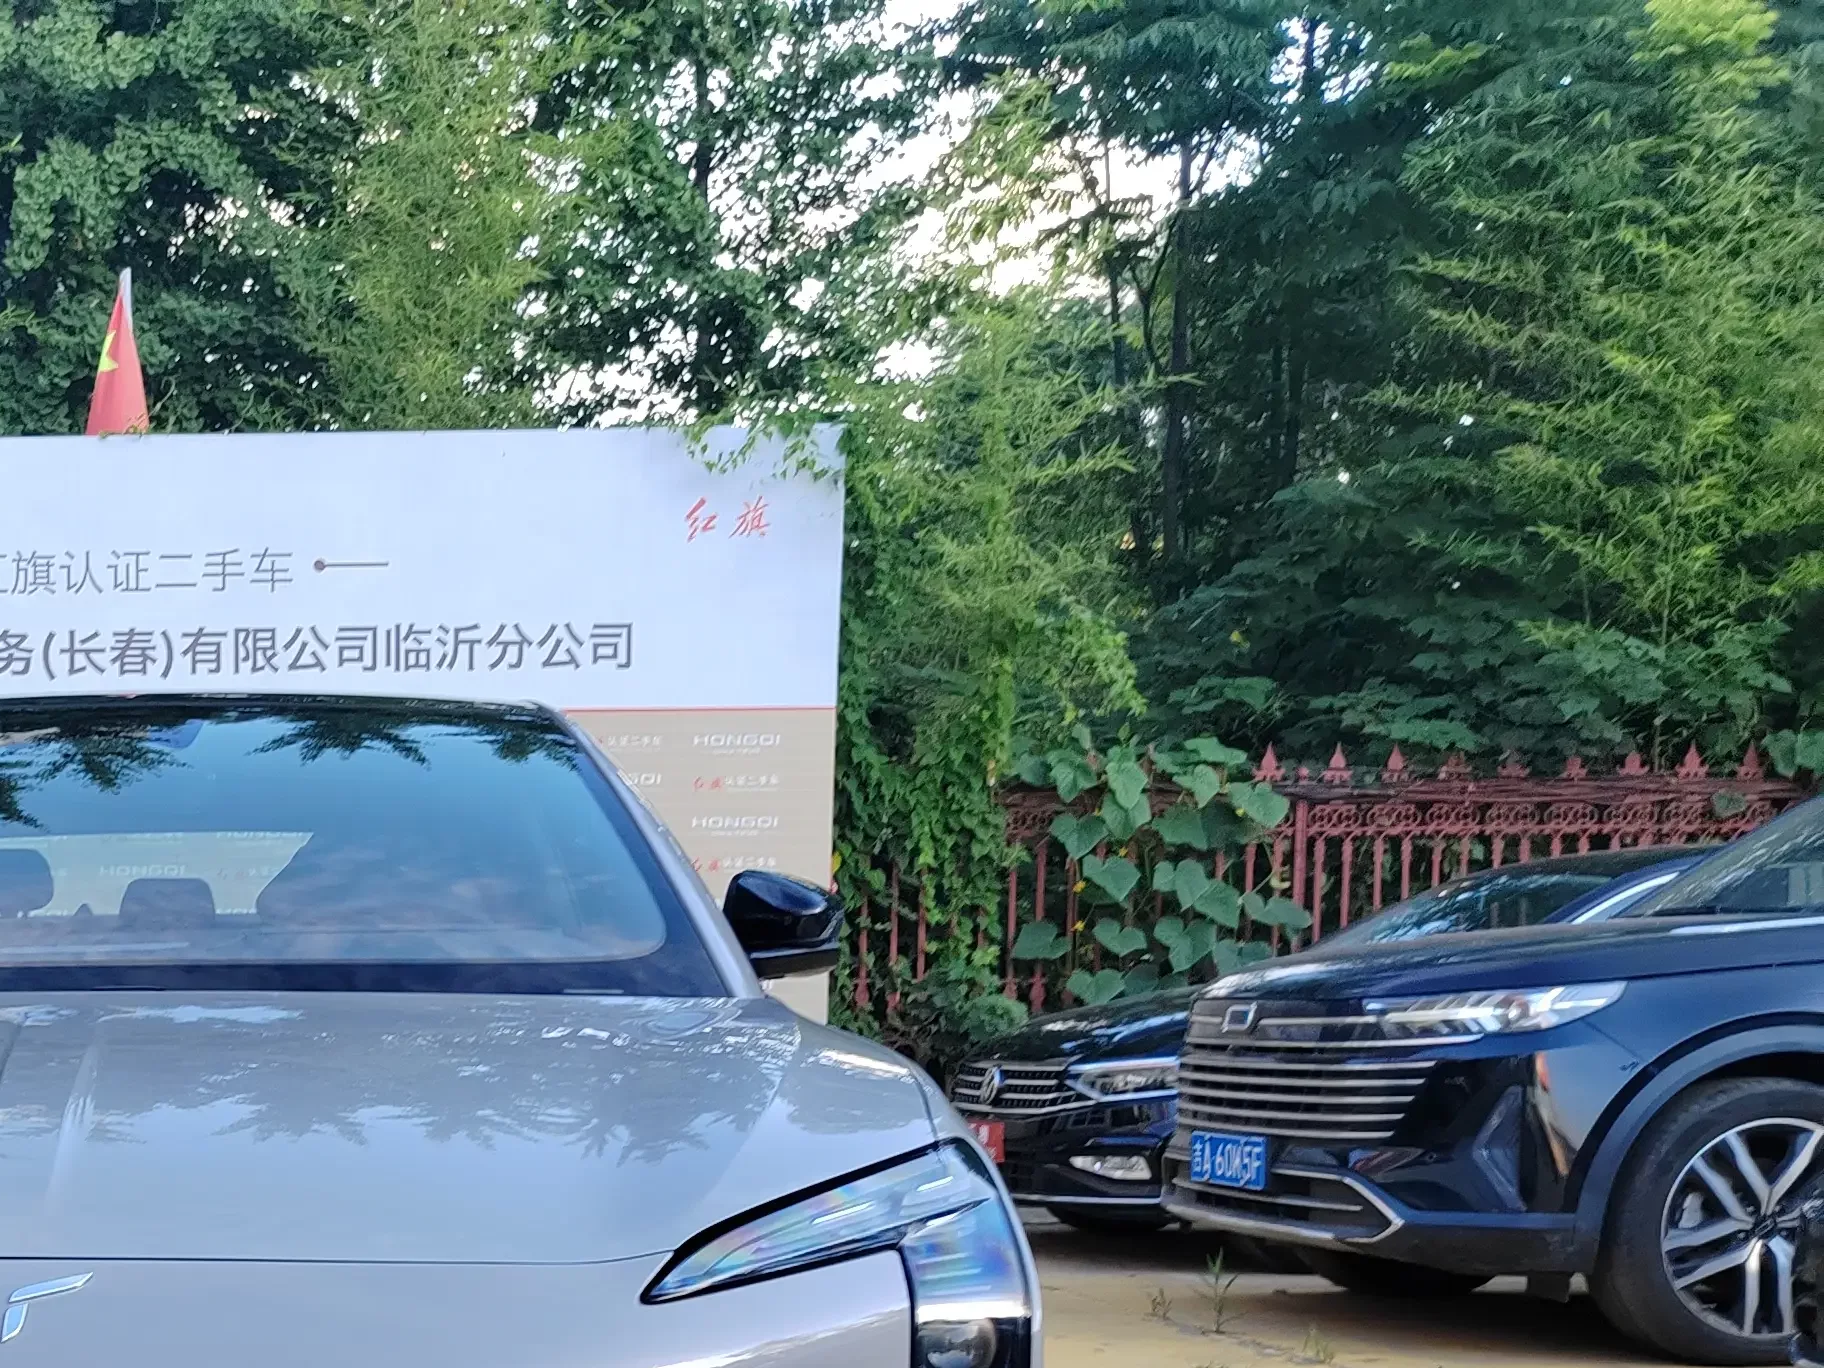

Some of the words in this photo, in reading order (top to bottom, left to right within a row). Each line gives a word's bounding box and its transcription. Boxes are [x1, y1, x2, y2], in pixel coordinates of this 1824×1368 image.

[684, 495, 771, 542] 红旗
[692, 733, 782, 747] HONGQI
[691, 815, 779, 829] HONGQI
